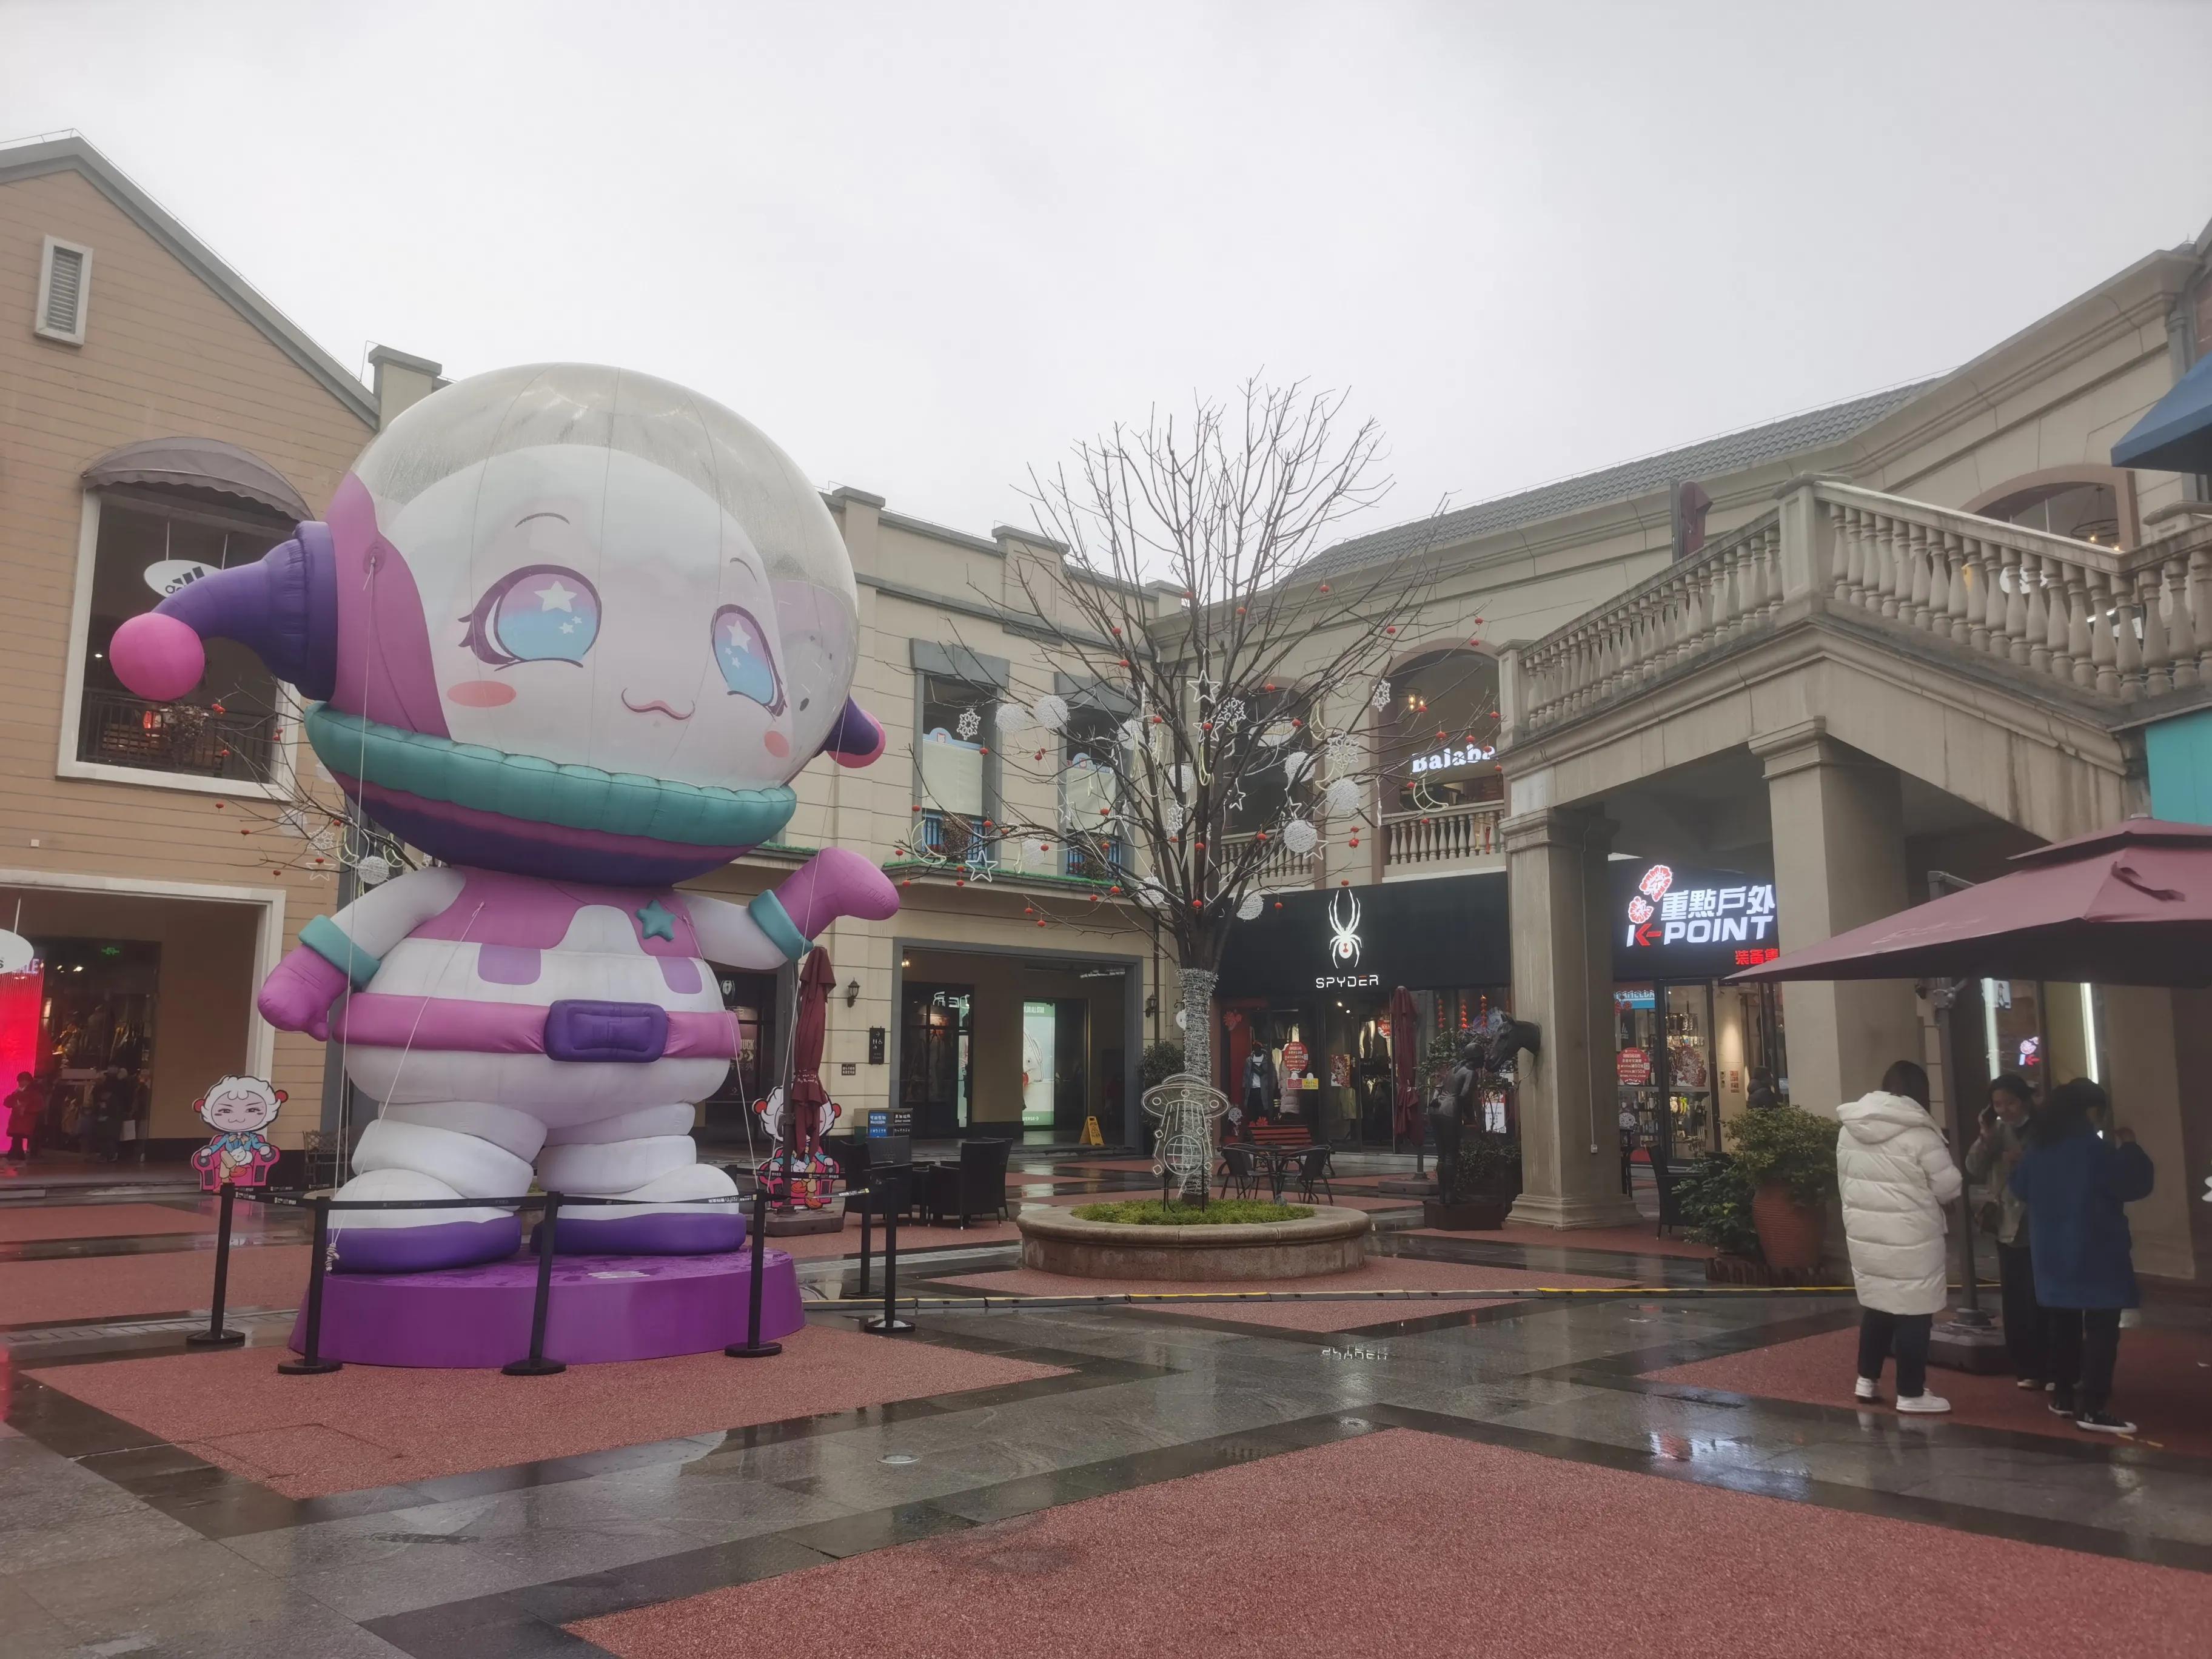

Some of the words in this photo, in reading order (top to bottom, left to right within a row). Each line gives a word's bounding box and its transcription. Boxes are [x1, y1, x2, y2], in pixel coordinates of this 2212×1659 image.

[1661, 885, 1775, 920] 重點戶外
[1626, 916, 1774, 947] K-POINT
[1316, 974, 1379, 988] SPYDER
